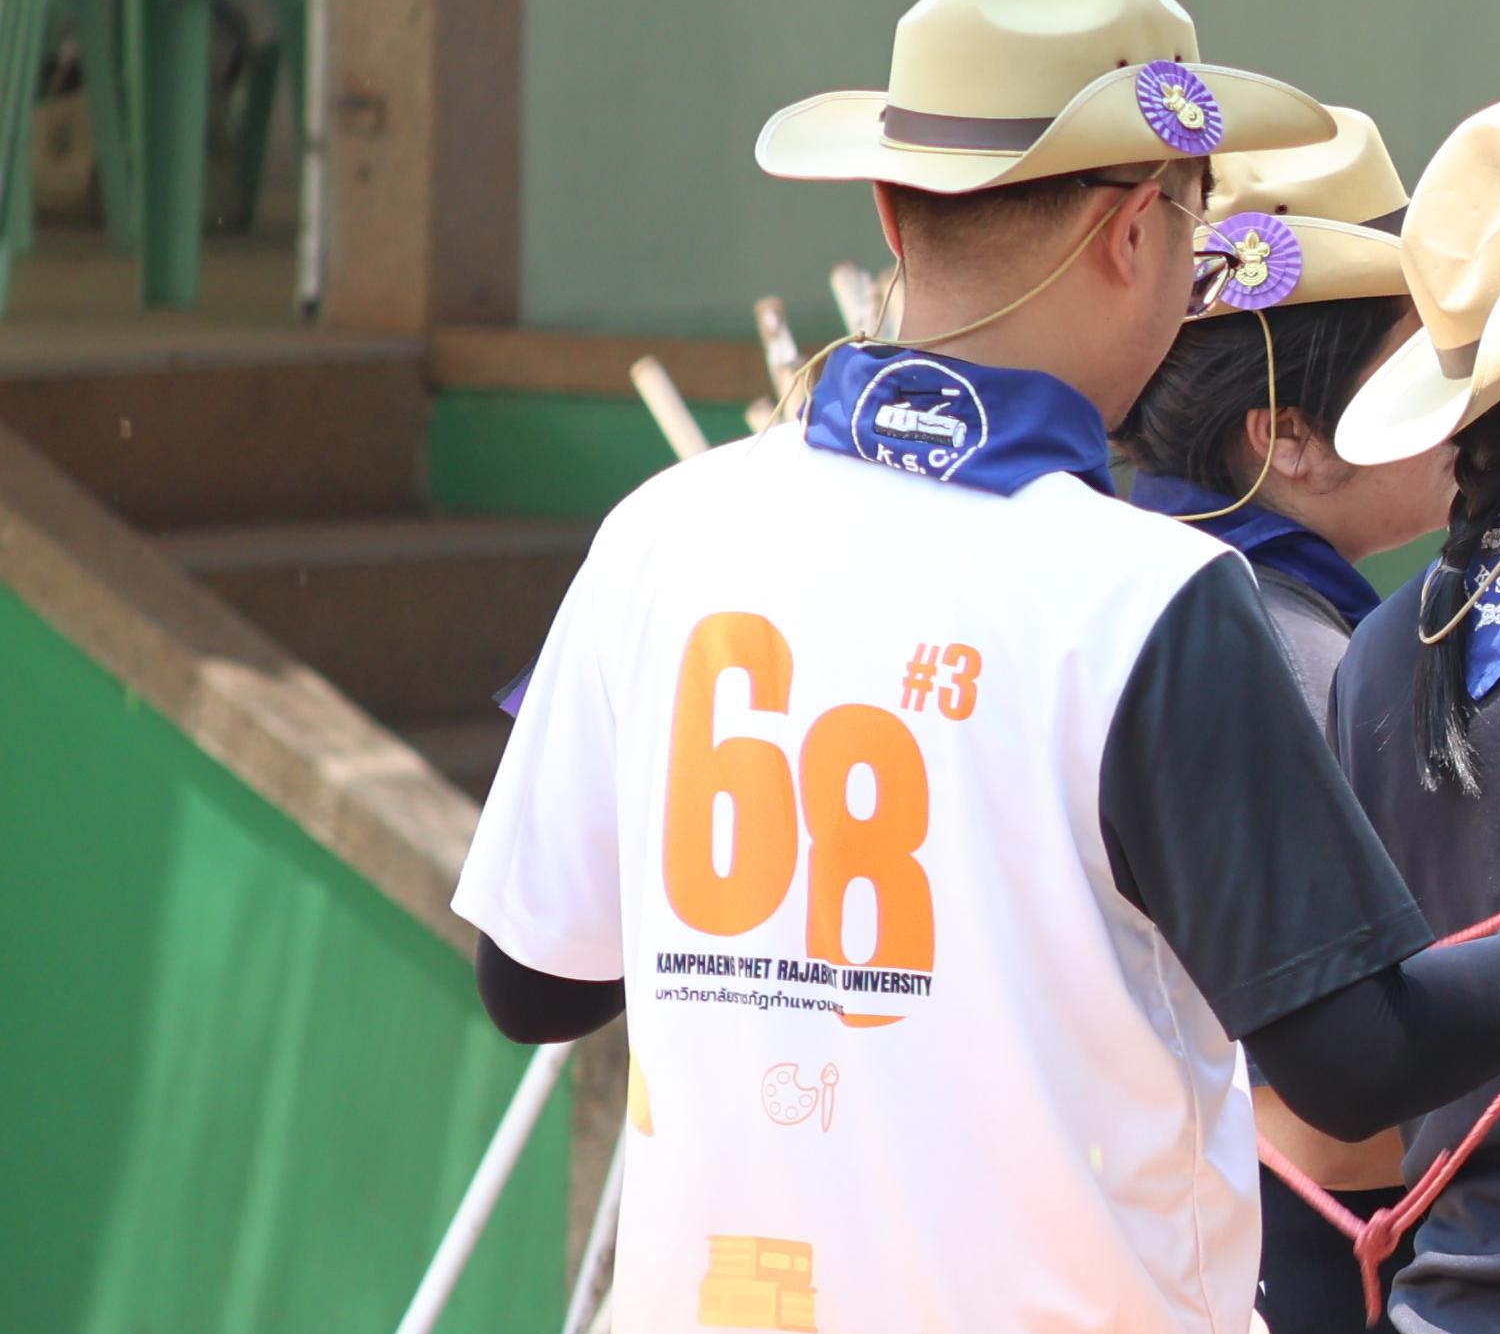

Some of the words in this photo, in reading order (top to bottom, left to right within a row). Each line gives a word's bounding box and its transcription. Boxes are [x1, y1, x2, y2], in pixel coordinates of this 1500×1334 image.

[900, 642, 983, 721] #3
[661, 611, 935, 1028] 68
[656, 952, 736, 977] KAMPHAENG
[737, 957, 772, 980] PHET
[776, 959, 838, 989] RAJABT
[842, 969, 932, 997] UNIVERSITY
